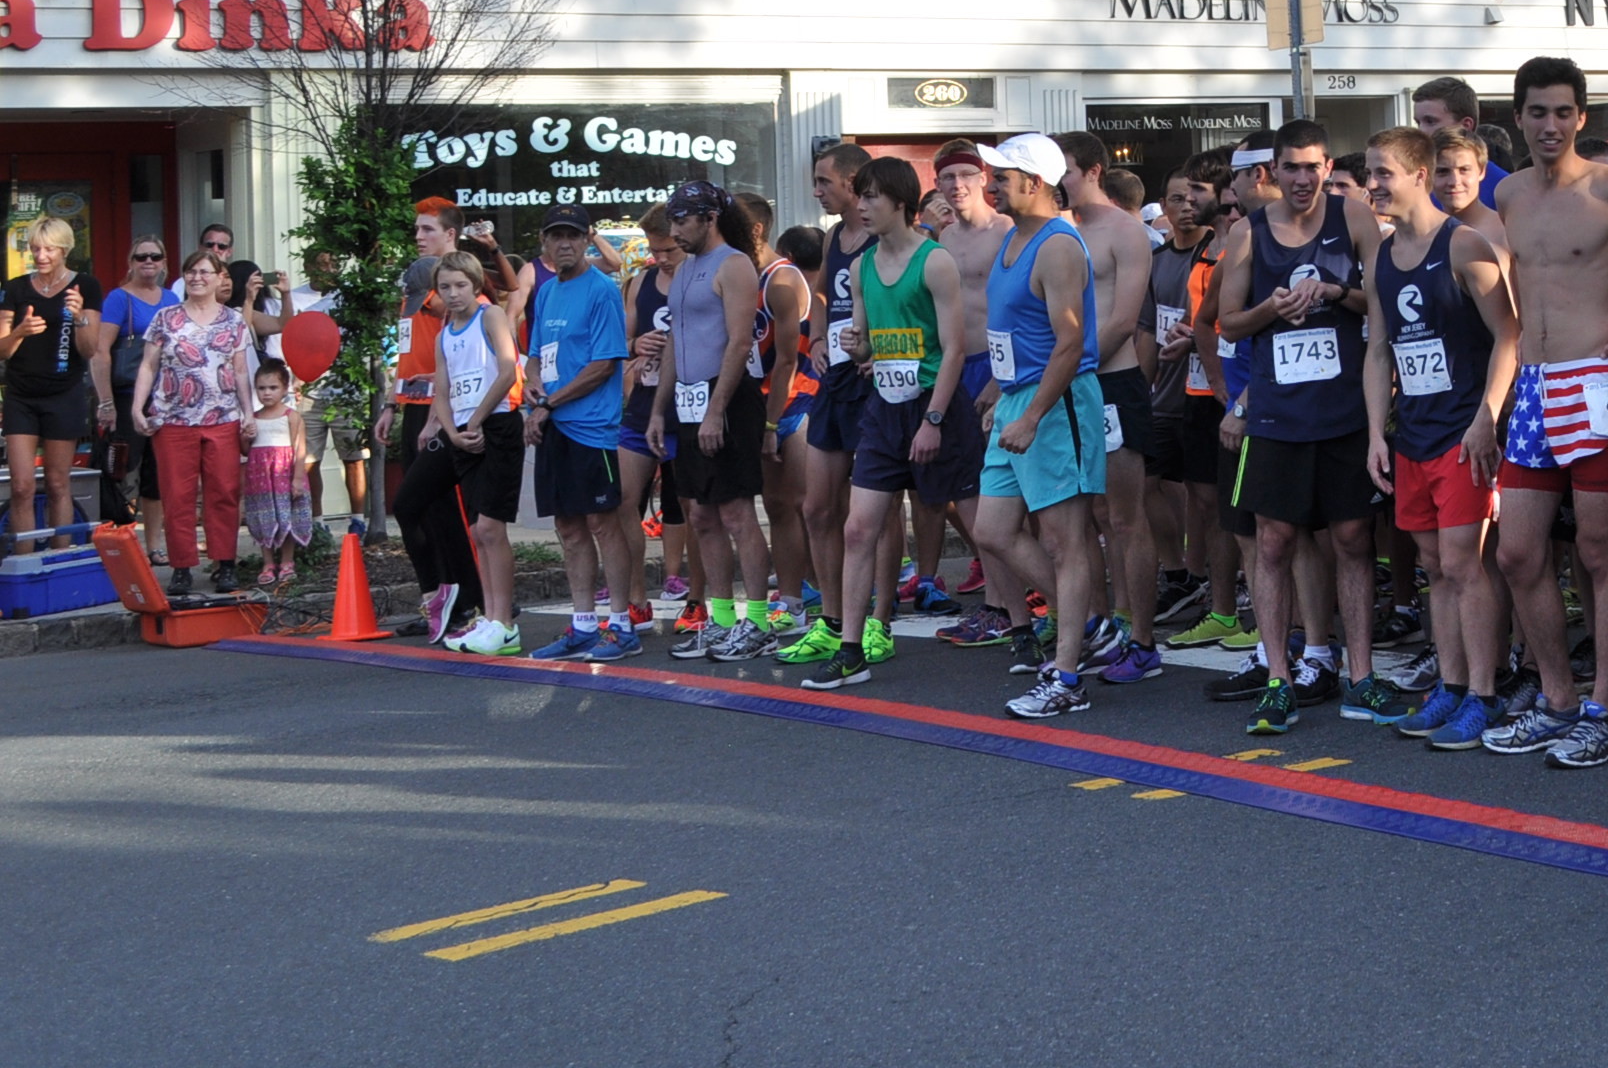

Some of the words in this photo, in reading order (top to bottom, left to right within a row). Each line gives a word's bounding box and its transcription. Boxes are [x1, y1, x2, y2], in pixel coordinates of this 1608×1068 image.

[1327, 75, 1356, 90] 258
[922, 84, 961, 102] 260
[1087, 116, 1142, 131] MADELINE
[1143, 116, 1173, 130] MOSS
[1180, 116, 1233, 130] MADELINE
[1233, 114, 1262, 129] MOSS
[401, 128, 518, 169] Toys
[529, 116, 572, 153] &
[583, 116, 738, 166] Games
[550, 159, 600, 178] that
[456, 187, 552, 208] Educate
[556, 187, 577, 204] &
[581, 184, 676, 205] Entertai
[540, 352, 555, 370] 14
[1278, 340, 1336, 365] 1743
[1399, 352, 1445, 376] 1872
[876, 370, 916, 388] 2190
[575, 614, 595, 622] USA
